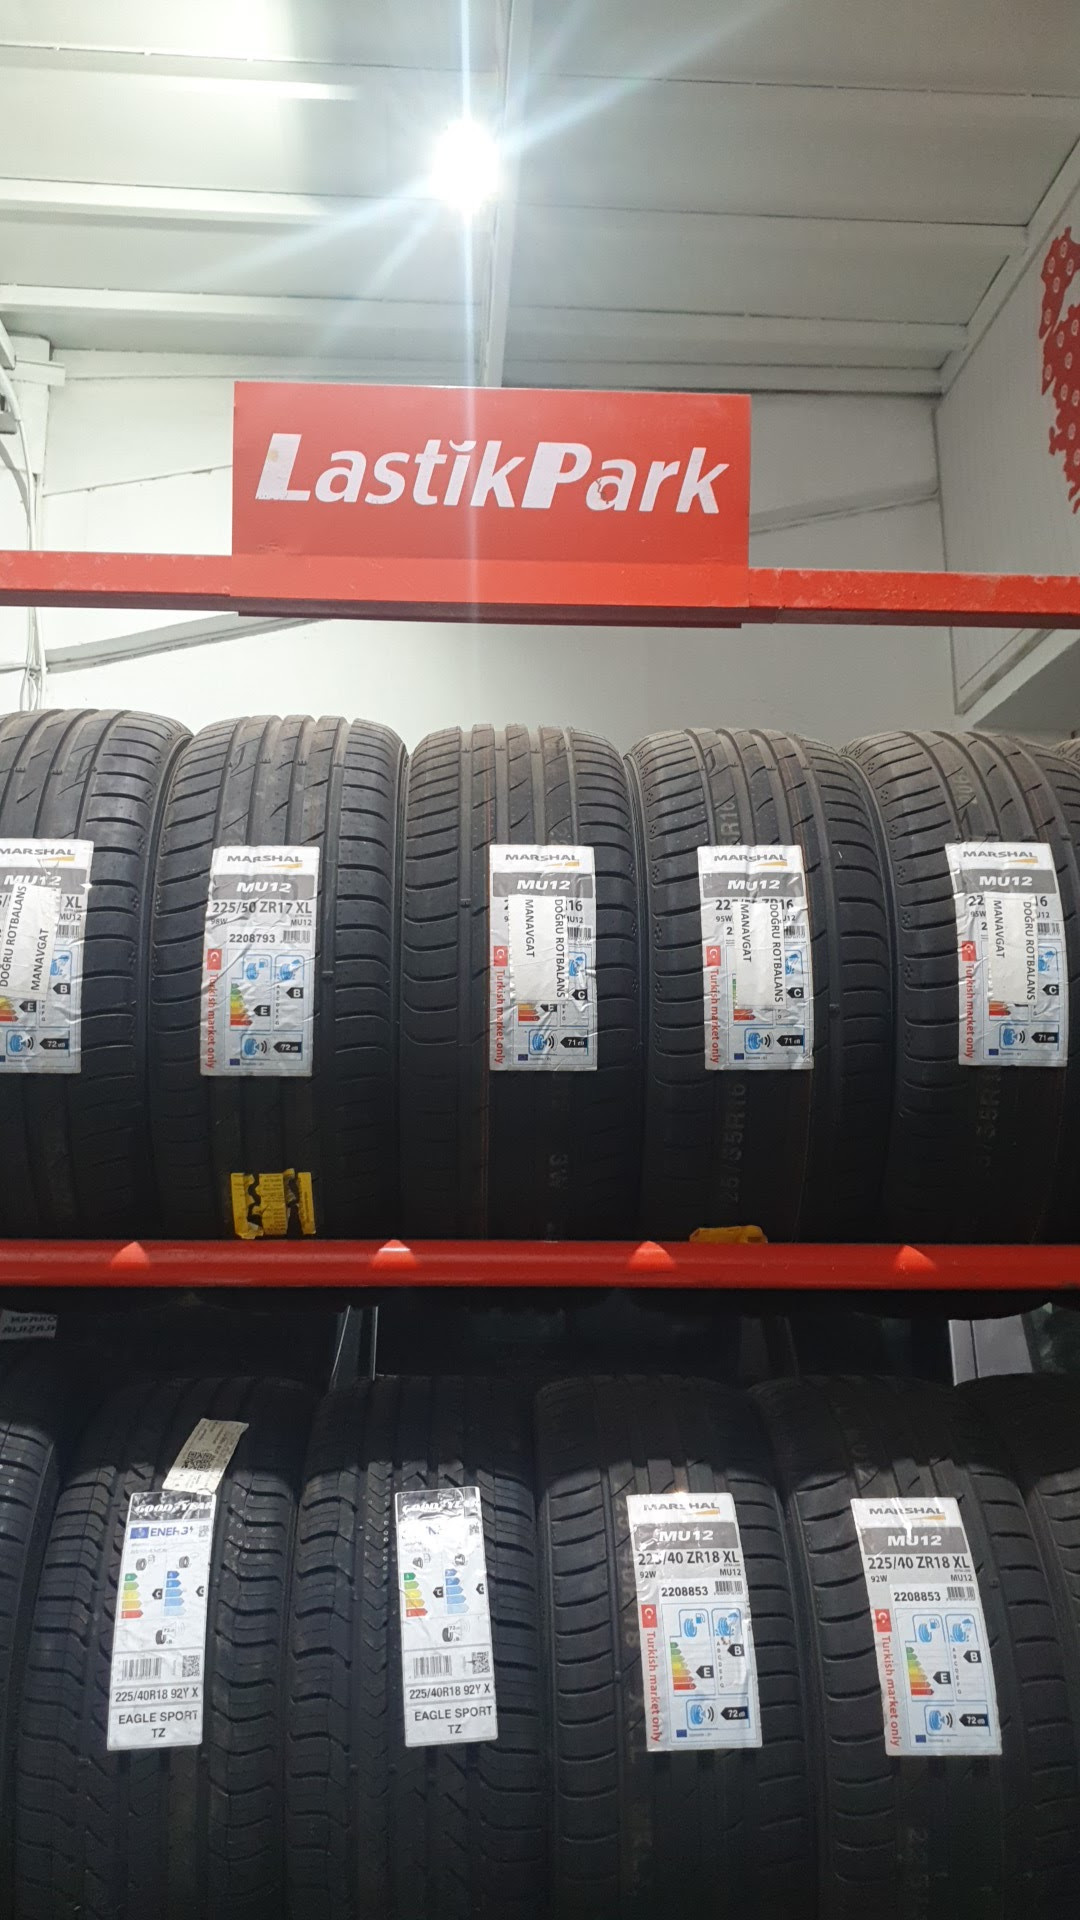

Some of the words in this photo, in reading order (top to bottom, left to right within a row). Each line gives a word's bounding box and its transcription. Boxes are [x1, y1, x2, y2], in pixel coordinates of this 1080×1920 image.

[4, 875, 61, 886] MU12
[236, 882, 292, 893] MU12
[517, 880, 570, 890] MU12
[727, 879, 780, 890] MU12
[979, 876, 1032, 886] MU12
[66, 896, 82, 908] XL
[212, 902, 256, 914] 225/50
[296, 902, 312, 914] XL
[525, 899, 535, 957] MANAVGAT
[741, 904, 751, 962] MANAVGAT
[994, 900, 1005, 958] MANAVGAT
[0, 948, 14, 987] DOĞRU
[7, 886, 27, 946] ROTBALANS
[229, 934, 275, 943] 2208793
[31, 928, 49, 990] MANAVGAT
[556, 938, 566, 998] ROTBALANS
[773, 942, 783, 1002] ROTBALANS
[1026, 940, 1036, 1000] ROTBALANS
[61, 984, 67, 993] B
[496, 970, 505, 1004] Turkish
[710, 969, 720, 1004] Turkish
[966, 965, 975, 998] Turkish
[293, 989, 301, 998] B
[794, 989, 801, 997] C
[1049, 986, 1056, 994] C
[28, 1003, 34, 1012] E
[261, 1007, 268, 1015] E
[496, 1005, 505, 1042] market
[711, 1005, 720, 1043] market
[967, 1001, 976, 1035] market
[207, 1012, 217, 1045] market
[495, 1043, 505, 1064] only
[711, 1043, 721, 1063] only
[965, 1036, 975, 1058] only
[205, 1047, 216, 1069] only
[659, 1530, 713, 1541] MU12
[888, 1535, 942, 1546] MU12
[687, 1551, 720, 1563] ZR18
[723, 1551, 739, 1563] XL
[868, 1557, 913, 1570] 225/40
[916, 1556, 950, 1568] ZR18
[952, 1556, 970, 1568] XL
[950, 1574, 973, 1582] MU12
[661, 1586, 708, 1597] 2208853
[894, 1591, 941, 1602] 2208853
[646, 1631, 658, 1672] Turkish
[734, 1645, 742, 1655] B
[882, 1636, 895, 1676] Turkish
[970, 1651, 979, 1661] B
[703, 1667, 711, 1677] E
[941, 1672, 949, 1683] E
[115, 1689, 168, 1702] 225/40R18
[171, 1688, 189, 1699] 92Y
[409, 1686, 461, 1699] 225/40R18
[464, 1685, 481, 1696] 92Y
[649, 1673, 660, 1714] market
[887, 1678, 899, 1719] market
[118, 1712, 157, 1724] EAGLE
[160, 1710, 198, 1722] SPORT
[414, 1709, 451, 1721] EAGLE
[455, 1706, 492, 1718] SPORT
[728, 1709, 738, 1717] 72
[966, 1716, 977, 1724] 72
[152, 1728, 166, 1738] TZ
[448, 1725, 462, 1734] TZ
[651, 1715, 662, 1742] only
[890, 1722, 902, 1747] only
